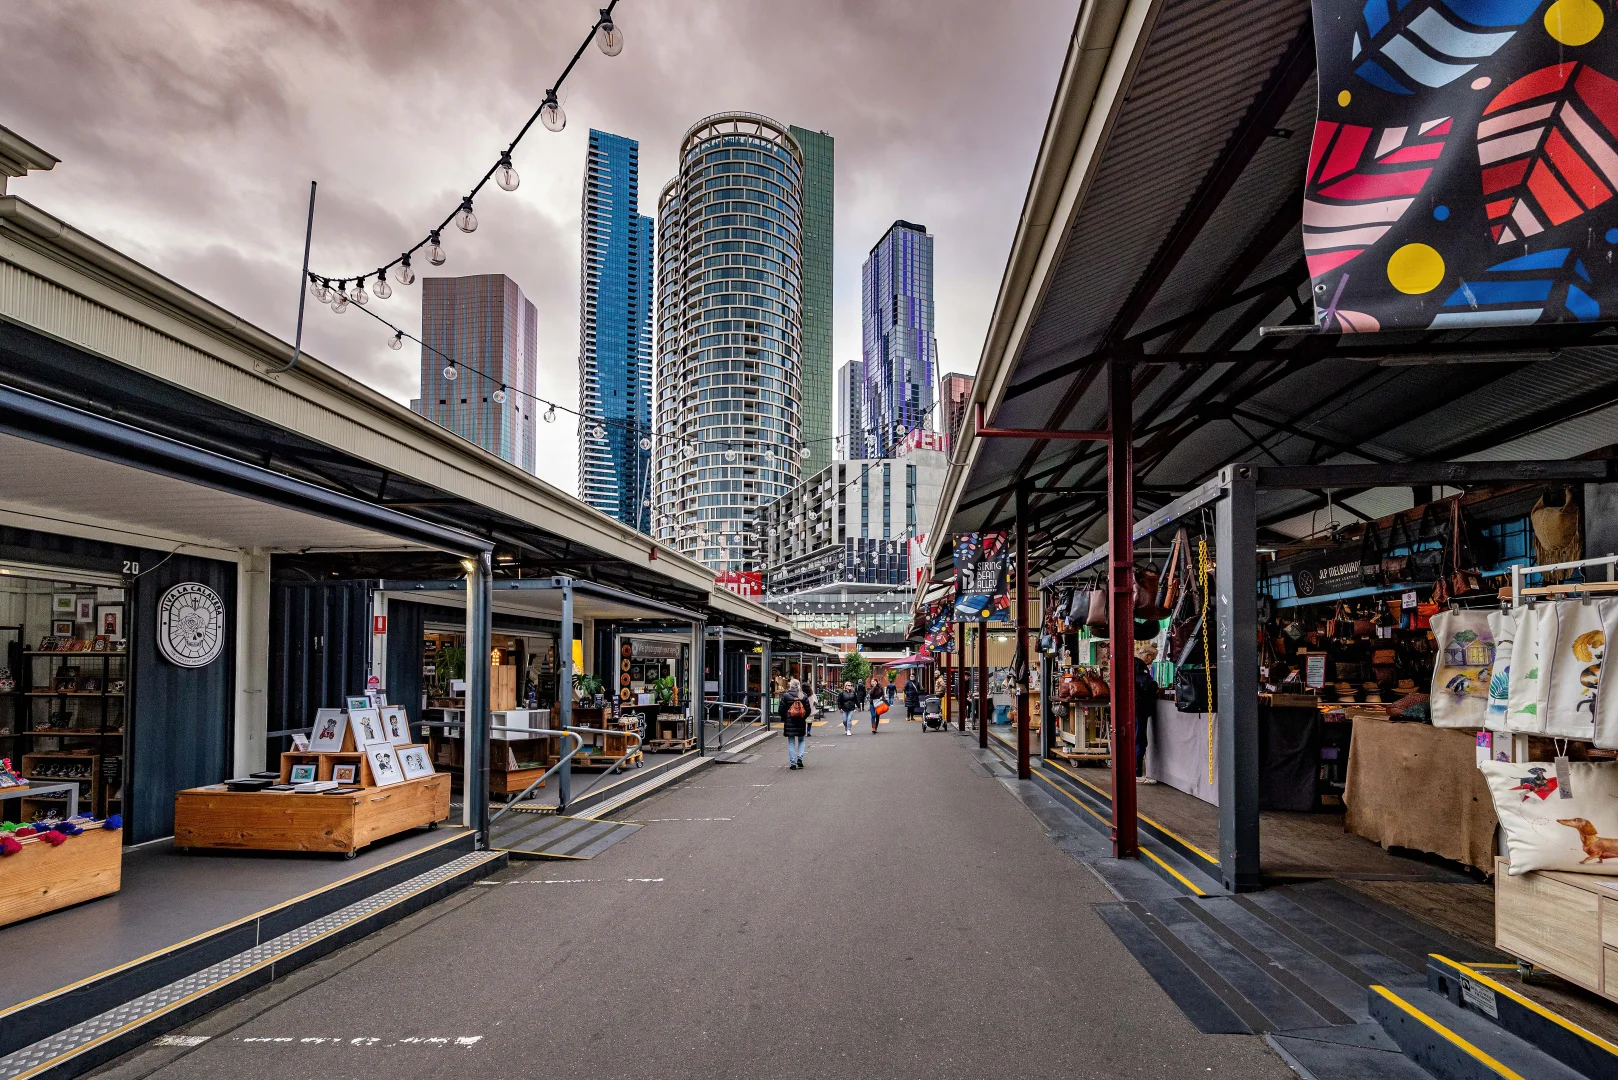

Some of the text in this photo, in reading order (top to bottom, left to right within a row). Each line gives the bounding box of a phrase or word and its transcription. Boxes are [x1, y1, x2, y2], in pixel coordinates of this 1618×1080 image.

[122, 560, 139, 575] 20
[977, 561, 1002, 571] STRING
[977, 571, 995, 580] BEAN
[977, 580, 997, 589] ALLEY
[163, 585, 223, 616] VIVA LA CALAVERA
